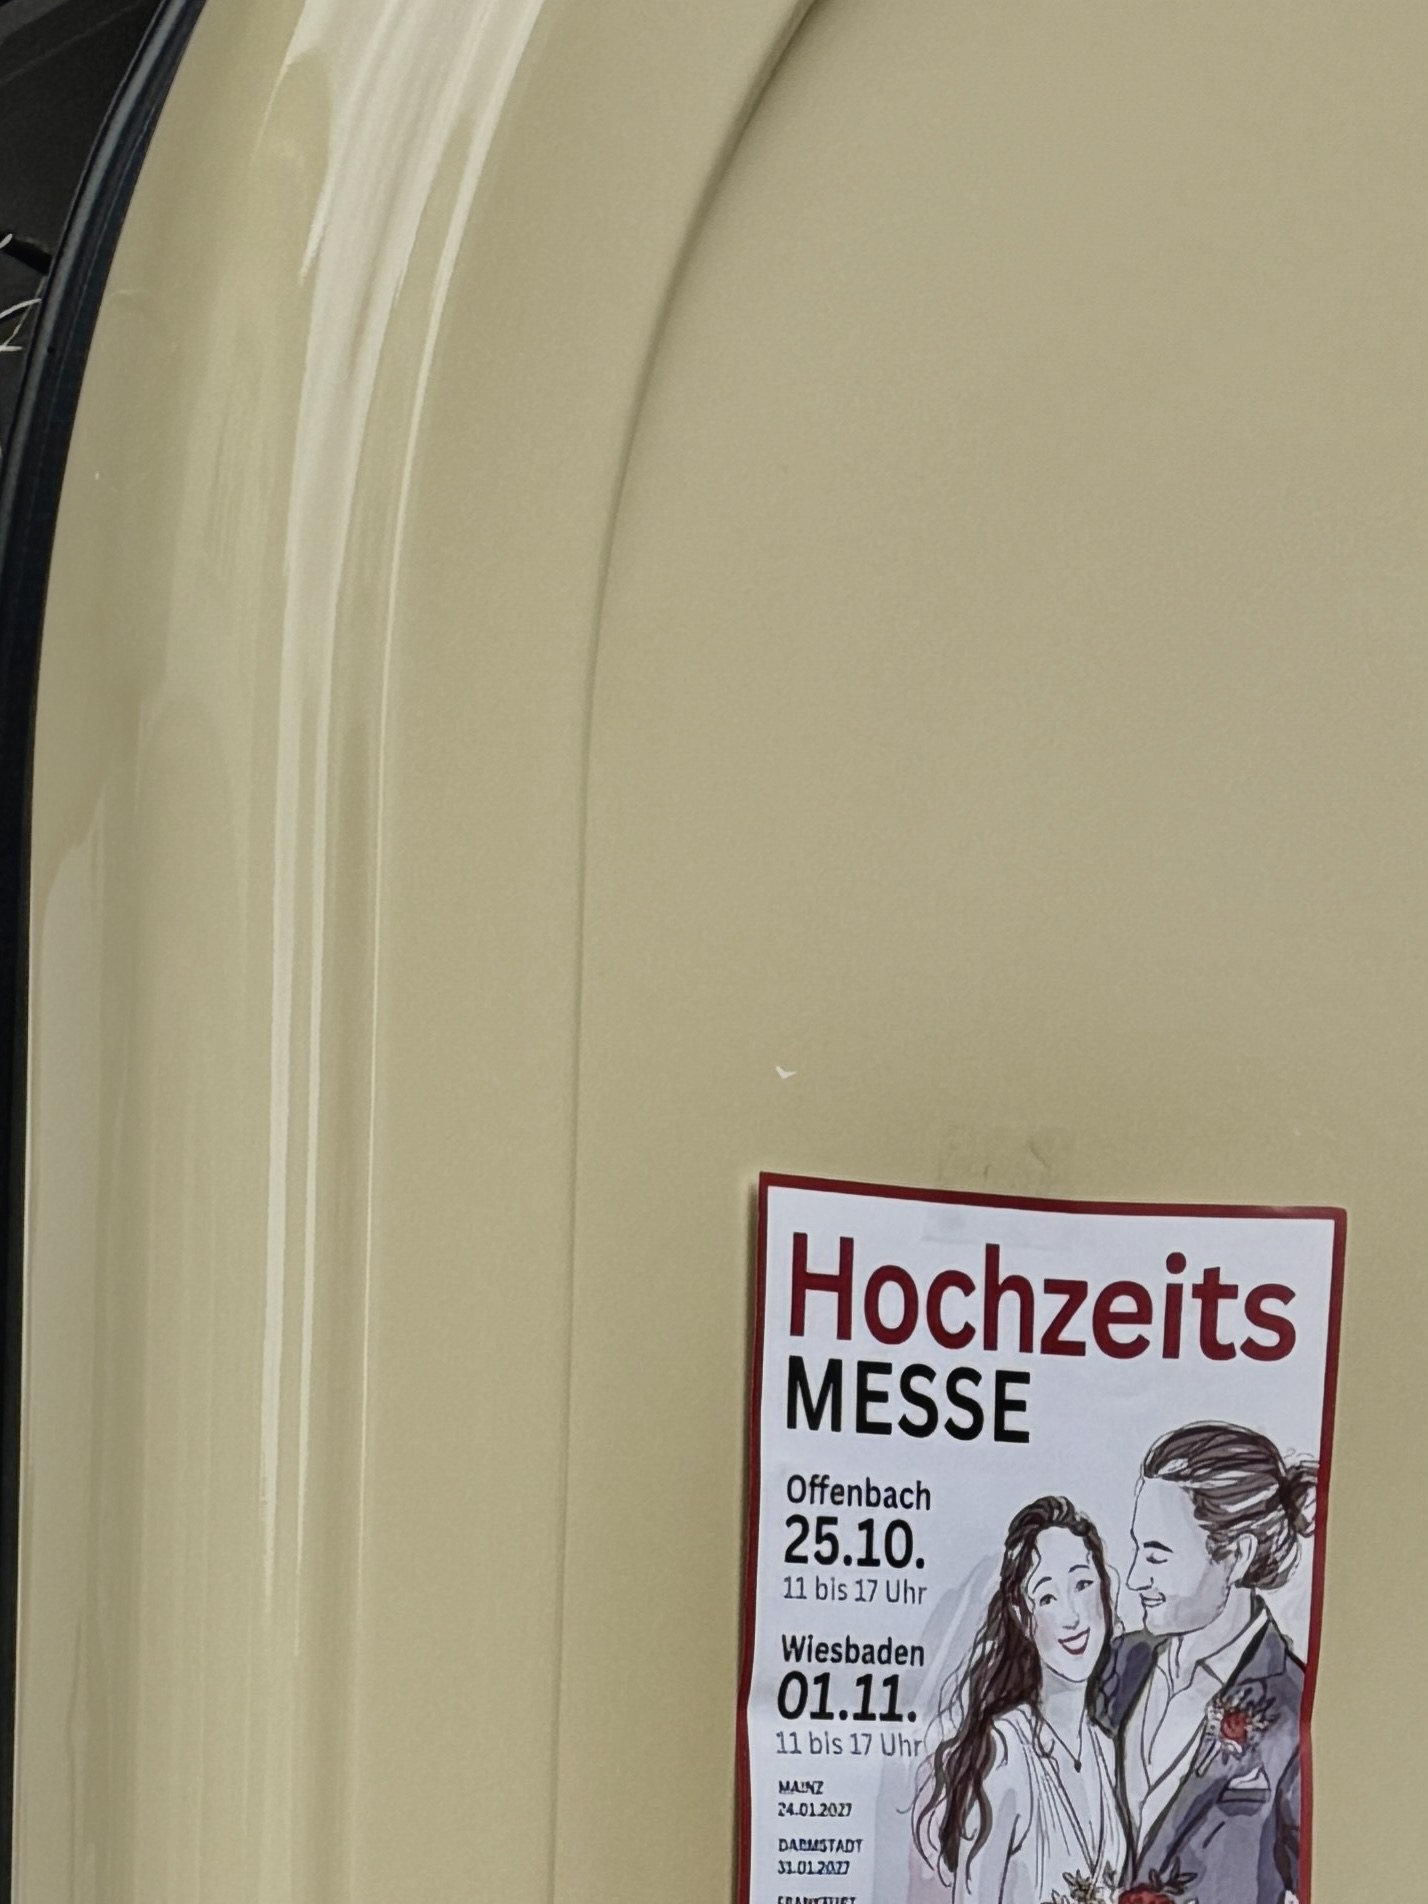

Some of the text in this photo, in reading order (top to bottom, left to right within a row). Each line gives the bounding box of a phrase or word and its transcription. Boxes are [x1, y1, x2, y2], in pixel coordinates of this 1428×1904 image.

[788, 1231, 1297, 1362] Hochzeits
[785, 1355, 1031, 1444] MESSE
[786, 1473, 931, 1511] Offenbach
[784, 1513, 925, 1569] 25.10.
[783, 1575, 928, 1605] 11 bis 17 Uhr
[781, 1633, 925, 1667] Wiesbaden
[777, 1670, 917, 1723] 01.11.
[776, 1730, 923, 1757] 11 bis 17 Uhr
[778, 1780, 825, 1795] MAINZ
[777, 1802, 853, 1818] 24.01.2027
[778, 1838, 864, 1853] DARMSTADT
